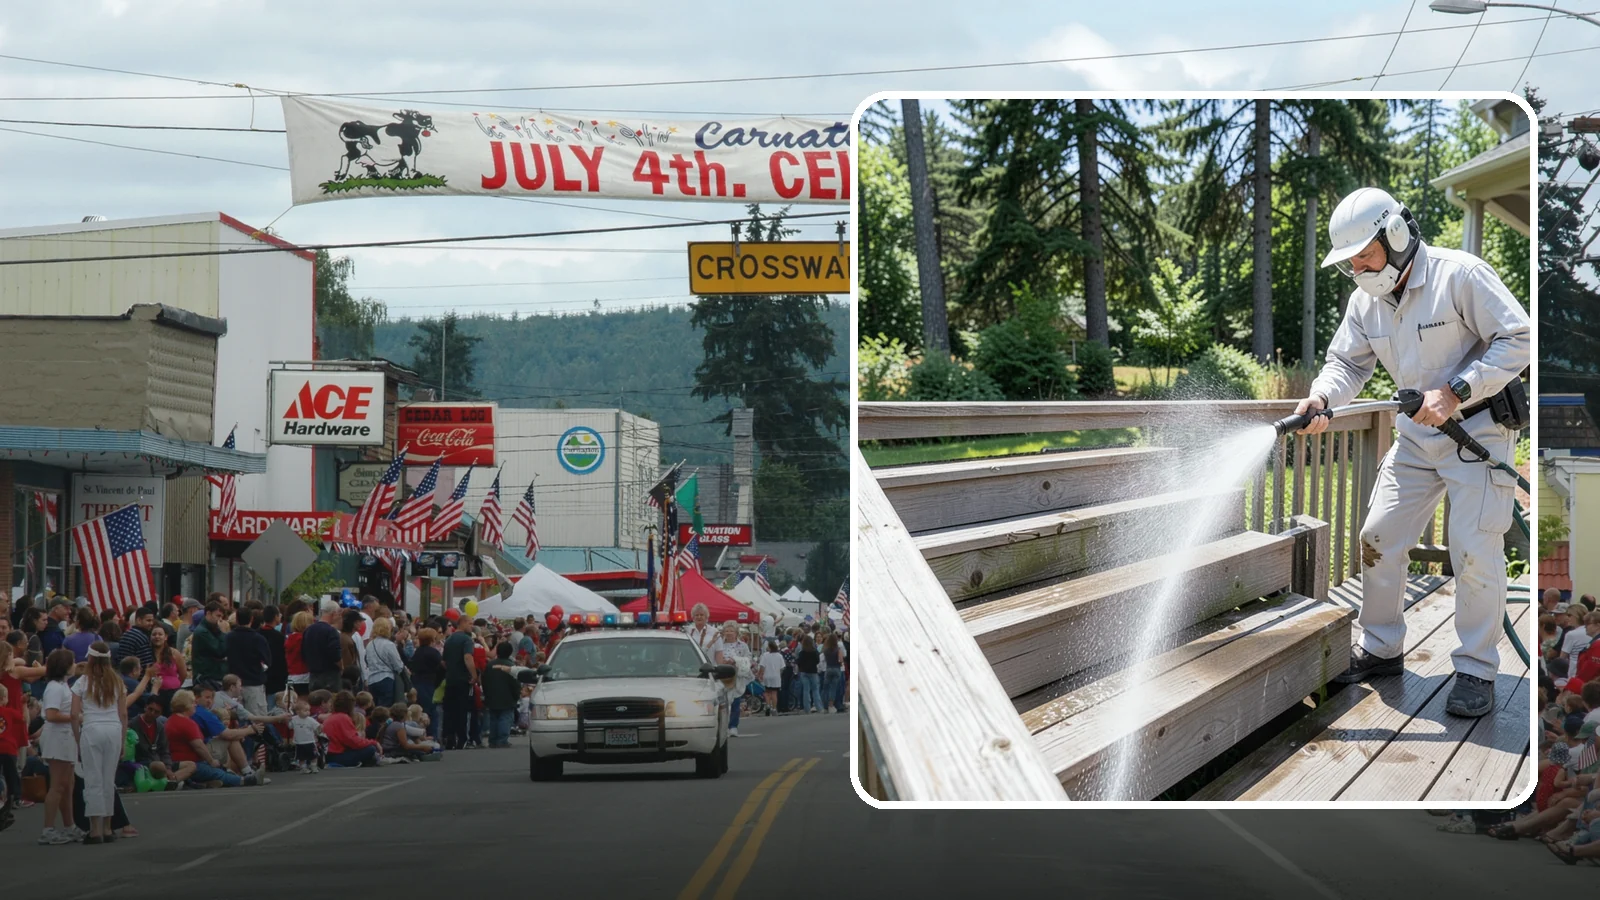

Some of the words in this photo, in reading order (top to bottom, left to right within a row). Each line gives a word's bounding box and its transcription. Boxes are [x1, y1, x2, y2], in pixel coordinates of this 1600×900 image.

[481, 141, 604, 193] JULY
[632, 150, 747, 198] 4th.
[697, 253, 850, 280] CROSSWA
[283, 379, 374, 420] ACE
[405, 408, 453, 422] CEDAR
[461, 409, 485, 422] LOG
[283, 420, 371, 437] Hardware
[353, 467, 384, 479] Simpl
[83, 485, 93, 494] St.
[95, 485, 124, 494] Vincent
[126, 485, 135, 494] de
[137, 486, 155, 495] Paul
[688, 526, 741, 535] CRNATION
[699, 535, 730, 543] GLASS
